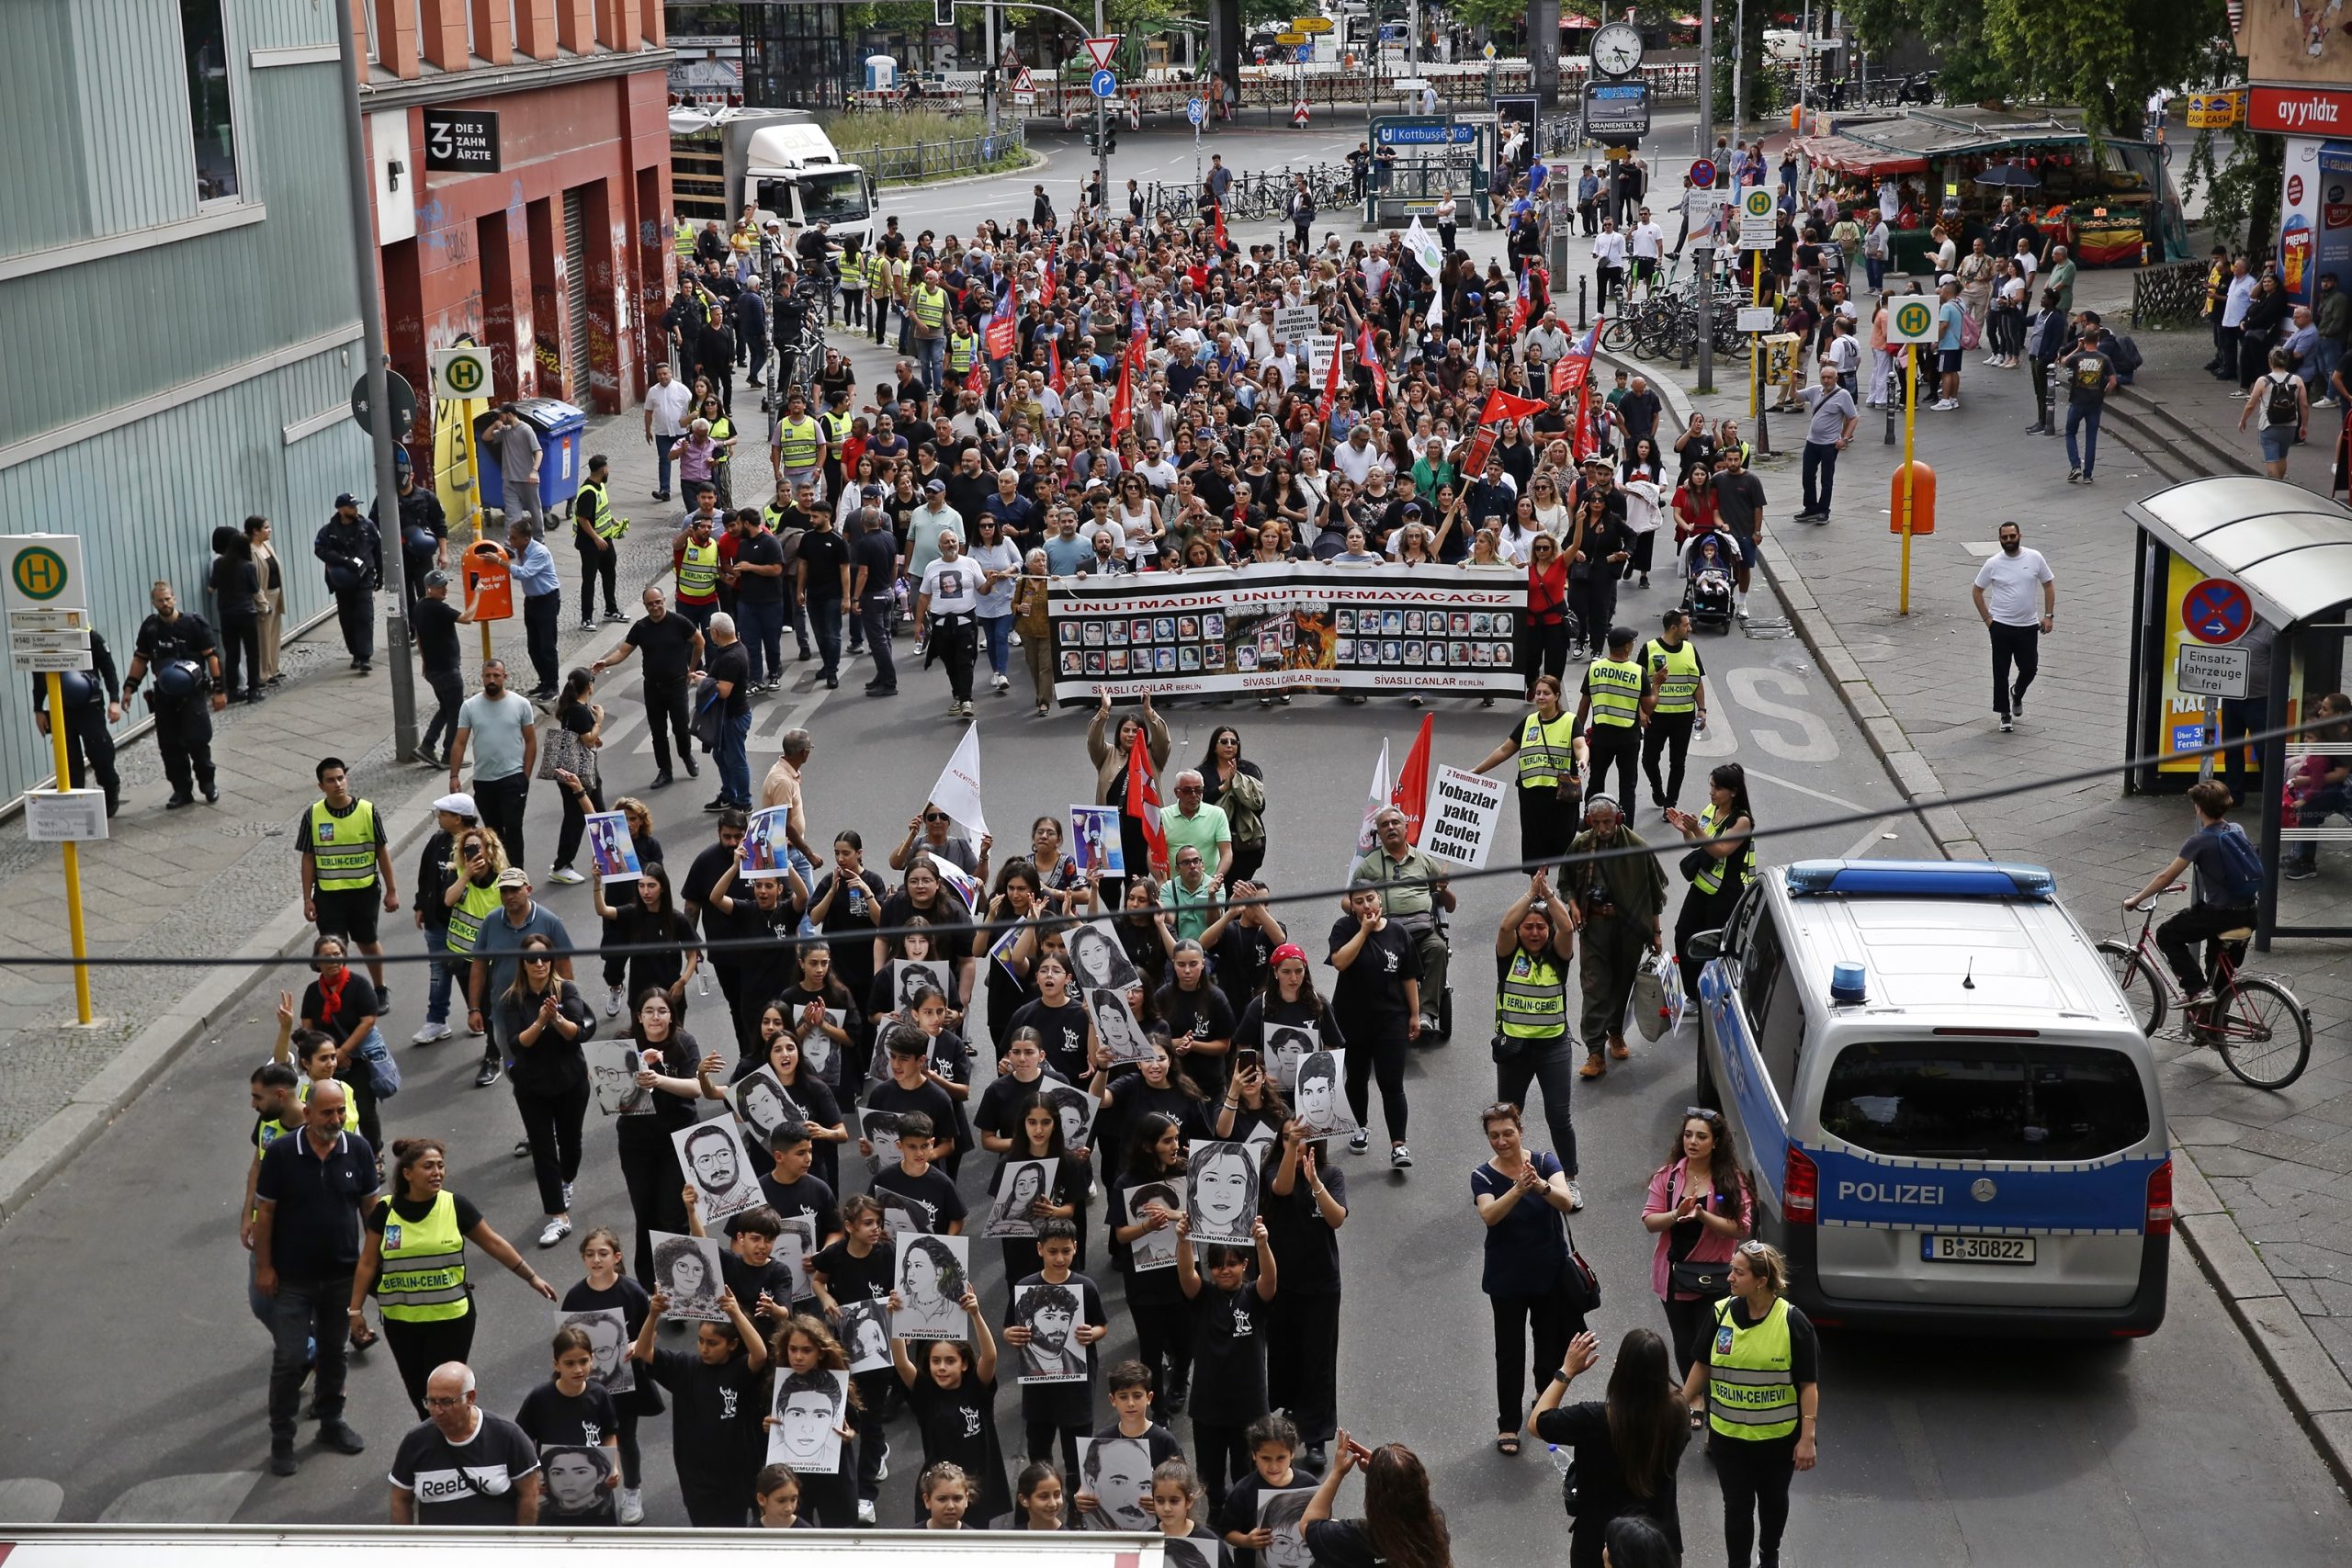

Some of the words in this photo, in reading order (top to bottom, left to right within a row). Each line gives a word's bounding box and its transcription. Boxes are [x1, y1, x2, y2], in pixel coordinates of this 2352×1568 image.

[2188, 114, 2202, 123] CASH
[2206, 115, 2230, 124] CASH
[455, 123, 474, 133] DIE
[476, 124, 483, 133] 3
[1398, 130, 1449, 139] Kottbusse
[1453, 128, 1469, 138] Tor
[456, 136, 486, 147] ZAHN
[457, 148, 492, 161] ÄRZTE
[2285, 231, 2309, 248] PREPAID
[1313, 339, 1335, 347] Türküle
[1063, 595, 1224, 612] UNUTMADIK
[1232, 590, 1511, 604] UNUTTURMAYACAĞIZ
[1225, 604, 1264, 616] SİVAS
[1269, 602, 1329, 614] 02-07-1993
[2189, 650, 2238, 665] Einsatz-
[1593, 667, 1638, 685] ORDNER
[2185, 663, 2243, 681] fahrzeuge
[1242, 676, 1281, 687] SİVASLI
[1281, 673, 1312, 684] CANLAR
[1315, 675, 1340, 683] BERLİN
[1374, 675, 1412, 685] SİVASLI
[1414, 676, 1456, 686] CANLAR
[1458, 678, 1485, 687] BERLİN
[2201, 679, 2222, 691] frei
[2177, 731, 2192, 740] Über
[1453, 772, 1481, 786] Temmuz
[1481, 778, 1498, 790] 1993
[1439, 780, 1498, 812] Yobazlar
[1442, 802, 1481, 827] yaktı,
[1435, 818, 1481, 845] Devlet
[1430, 837, 1466, 861] baktı
[1468, 847, 1477, 863] !
[1838, 1180, 1944, 1205] POLIZEI
[707, 1199, 760, 1223] ONURUMUZDUR
[1191, 1234, 1249, 1244] ONURUMUZDUR
[1943, 1238, 1955, 1257] B
[1967, 1238, 2025, 1259] 30822
[1141, 1259, 1178, 1269] ONURUMU
[1023, 1373, 1081, 1382] ONURUMUZDUR
[1716, 1382, 1786, 1404] BERLIN-CEMEVI
